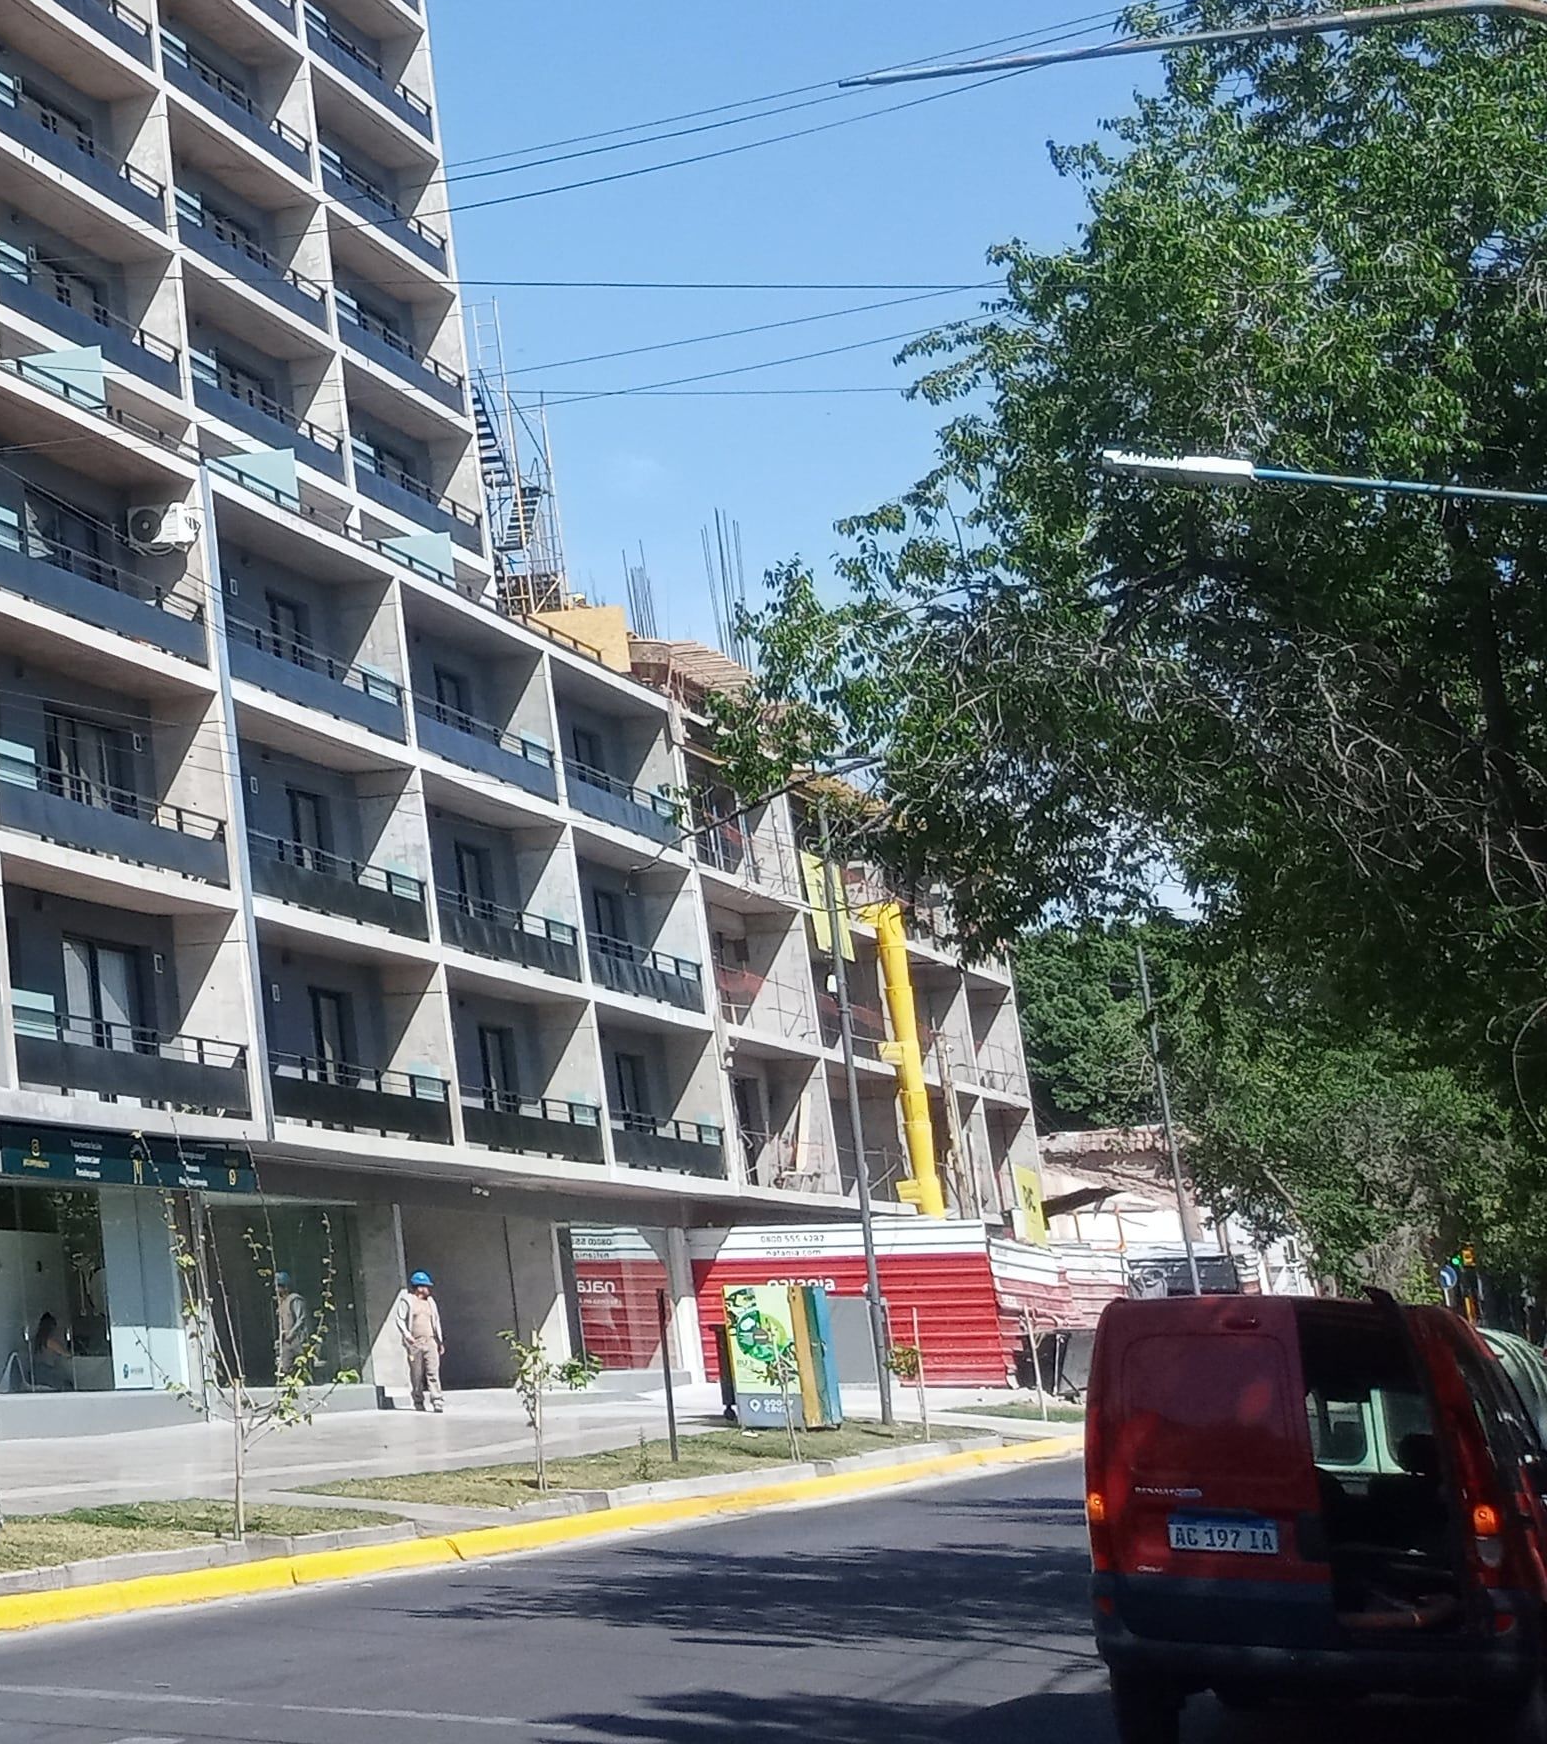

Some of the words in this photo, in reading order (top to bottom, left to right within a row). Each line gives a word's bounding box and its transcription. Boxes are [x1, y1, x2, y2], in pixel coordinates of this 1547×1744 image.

[1175, 1527, 1198, 1546] AC
[1204, 1528, 1241, 1548] 197
[1250, 1530, 1274, 1550] IA
